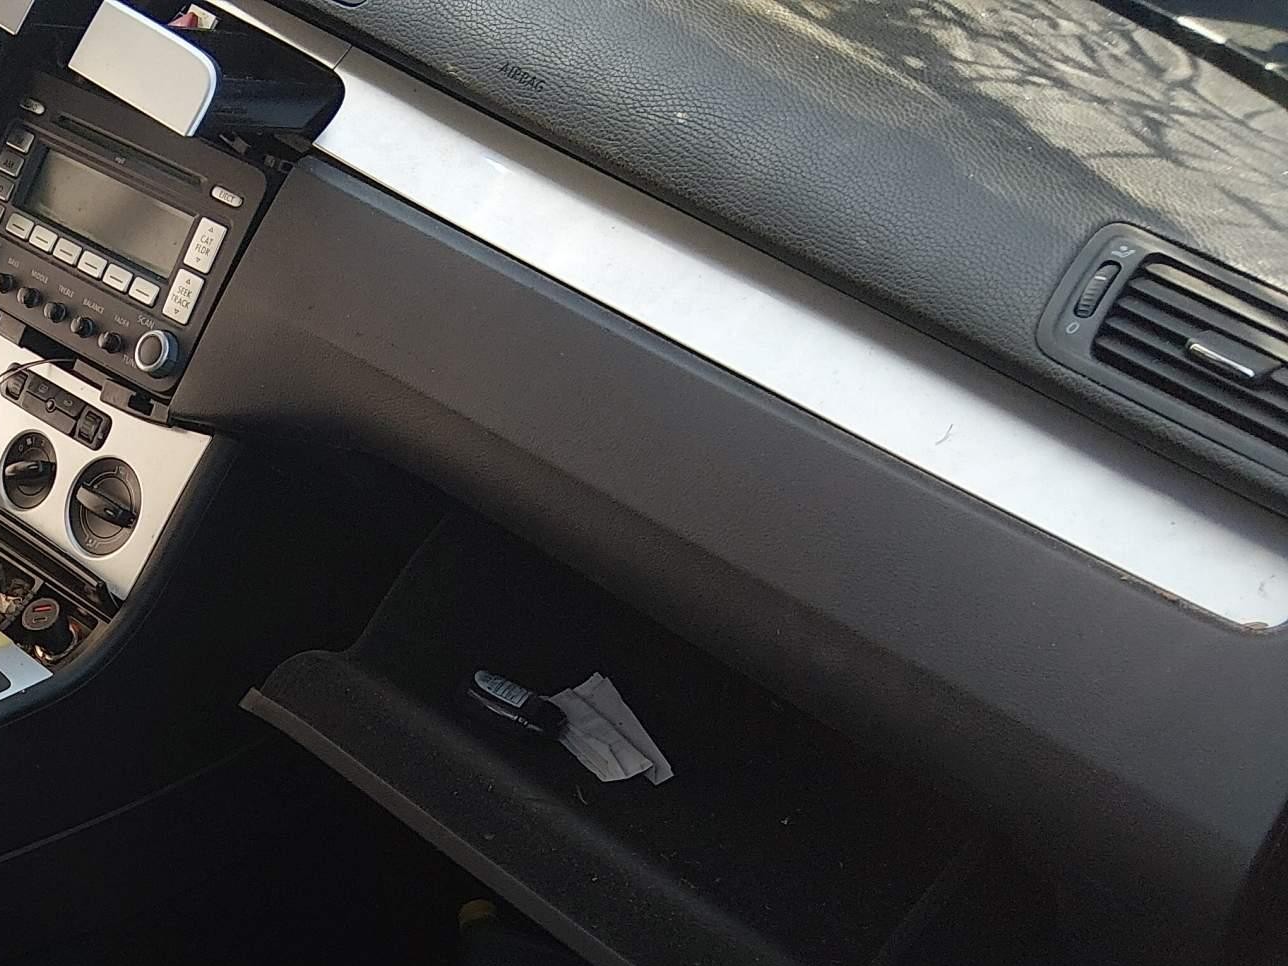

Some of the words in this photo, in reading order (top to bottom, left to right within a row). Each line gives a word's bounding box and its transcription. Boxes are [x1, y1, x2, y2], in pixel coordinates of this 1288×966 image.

[499, 61, 545, 92] AIRBAG
[218, 188, 235, 203] EJECT
[200, 234, 214, 245] CAT
[194, 243, 211, 257] FLDR
[176, 285, 193, 298] SEEK
[171, 293, 191, 309] TRACK
[136, 313, 156, 330] SCAN
